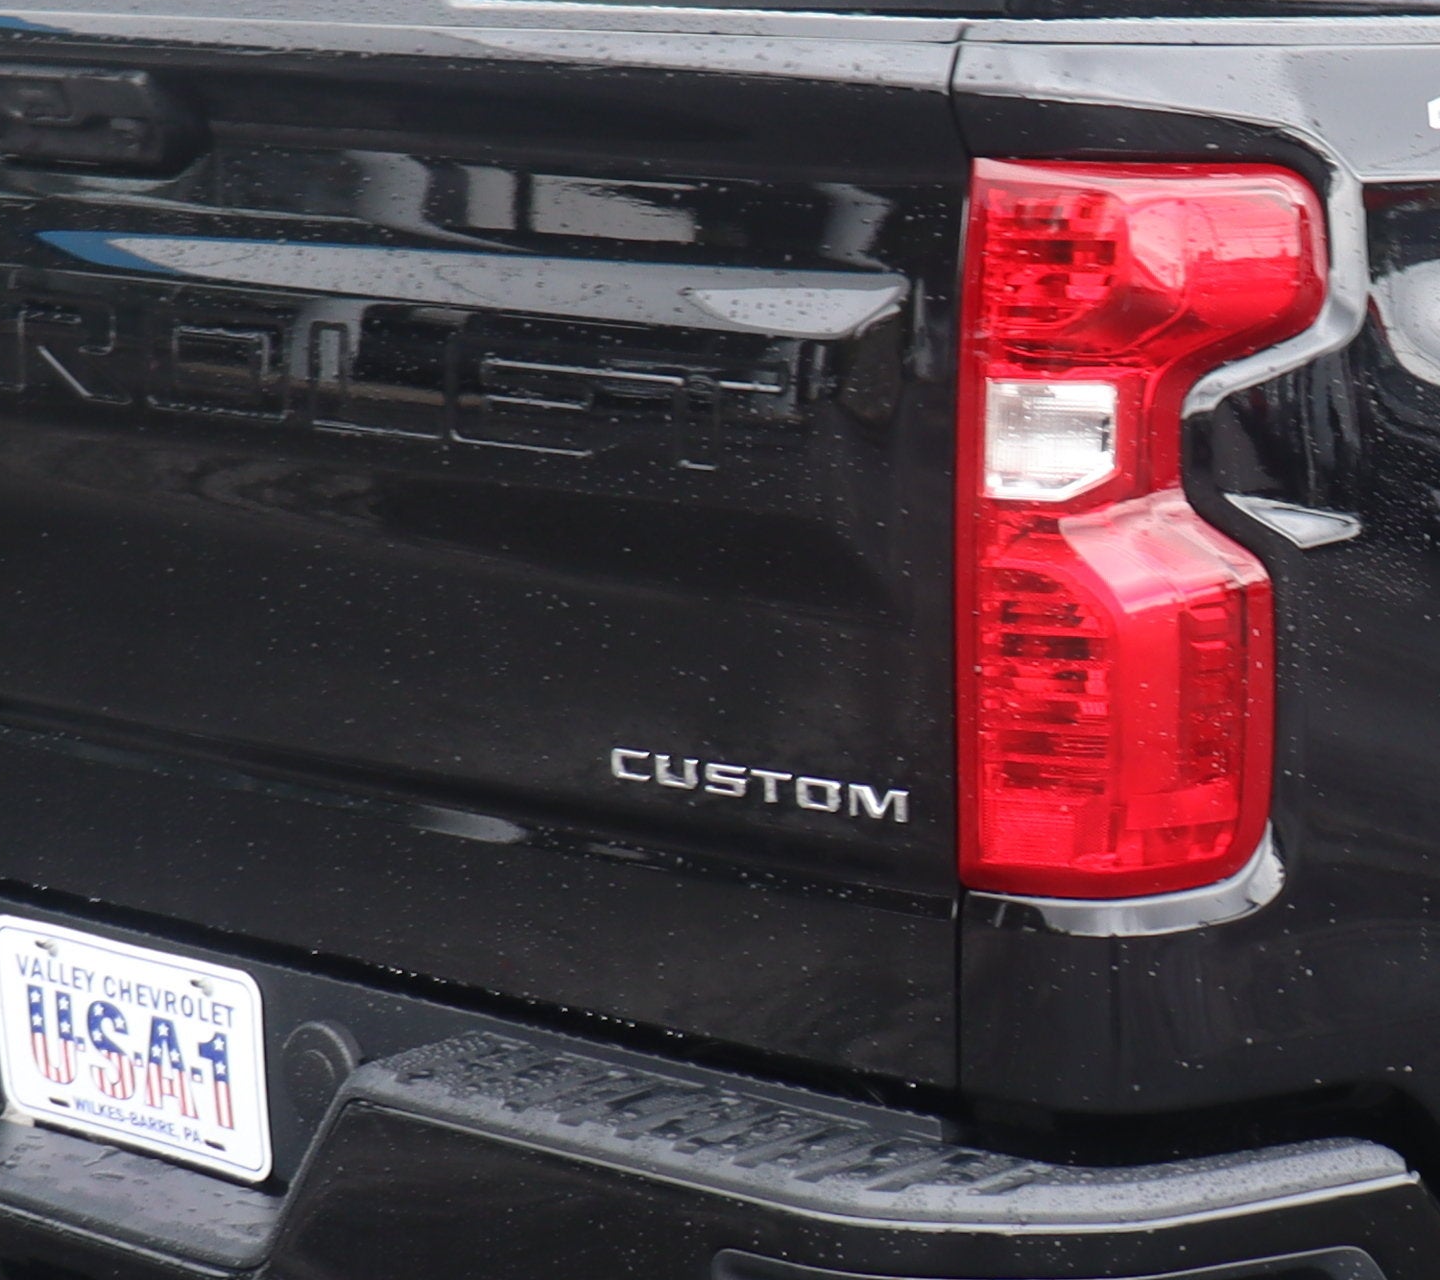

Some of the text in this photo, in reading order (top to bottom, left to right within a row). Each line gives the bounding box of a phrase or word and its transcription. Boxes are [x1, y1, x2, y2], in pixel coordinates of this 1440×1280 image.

[611, 747, 909, 823] CUSTOM
[16, 953, 234, 1028] VALLEY CHEVROLET
